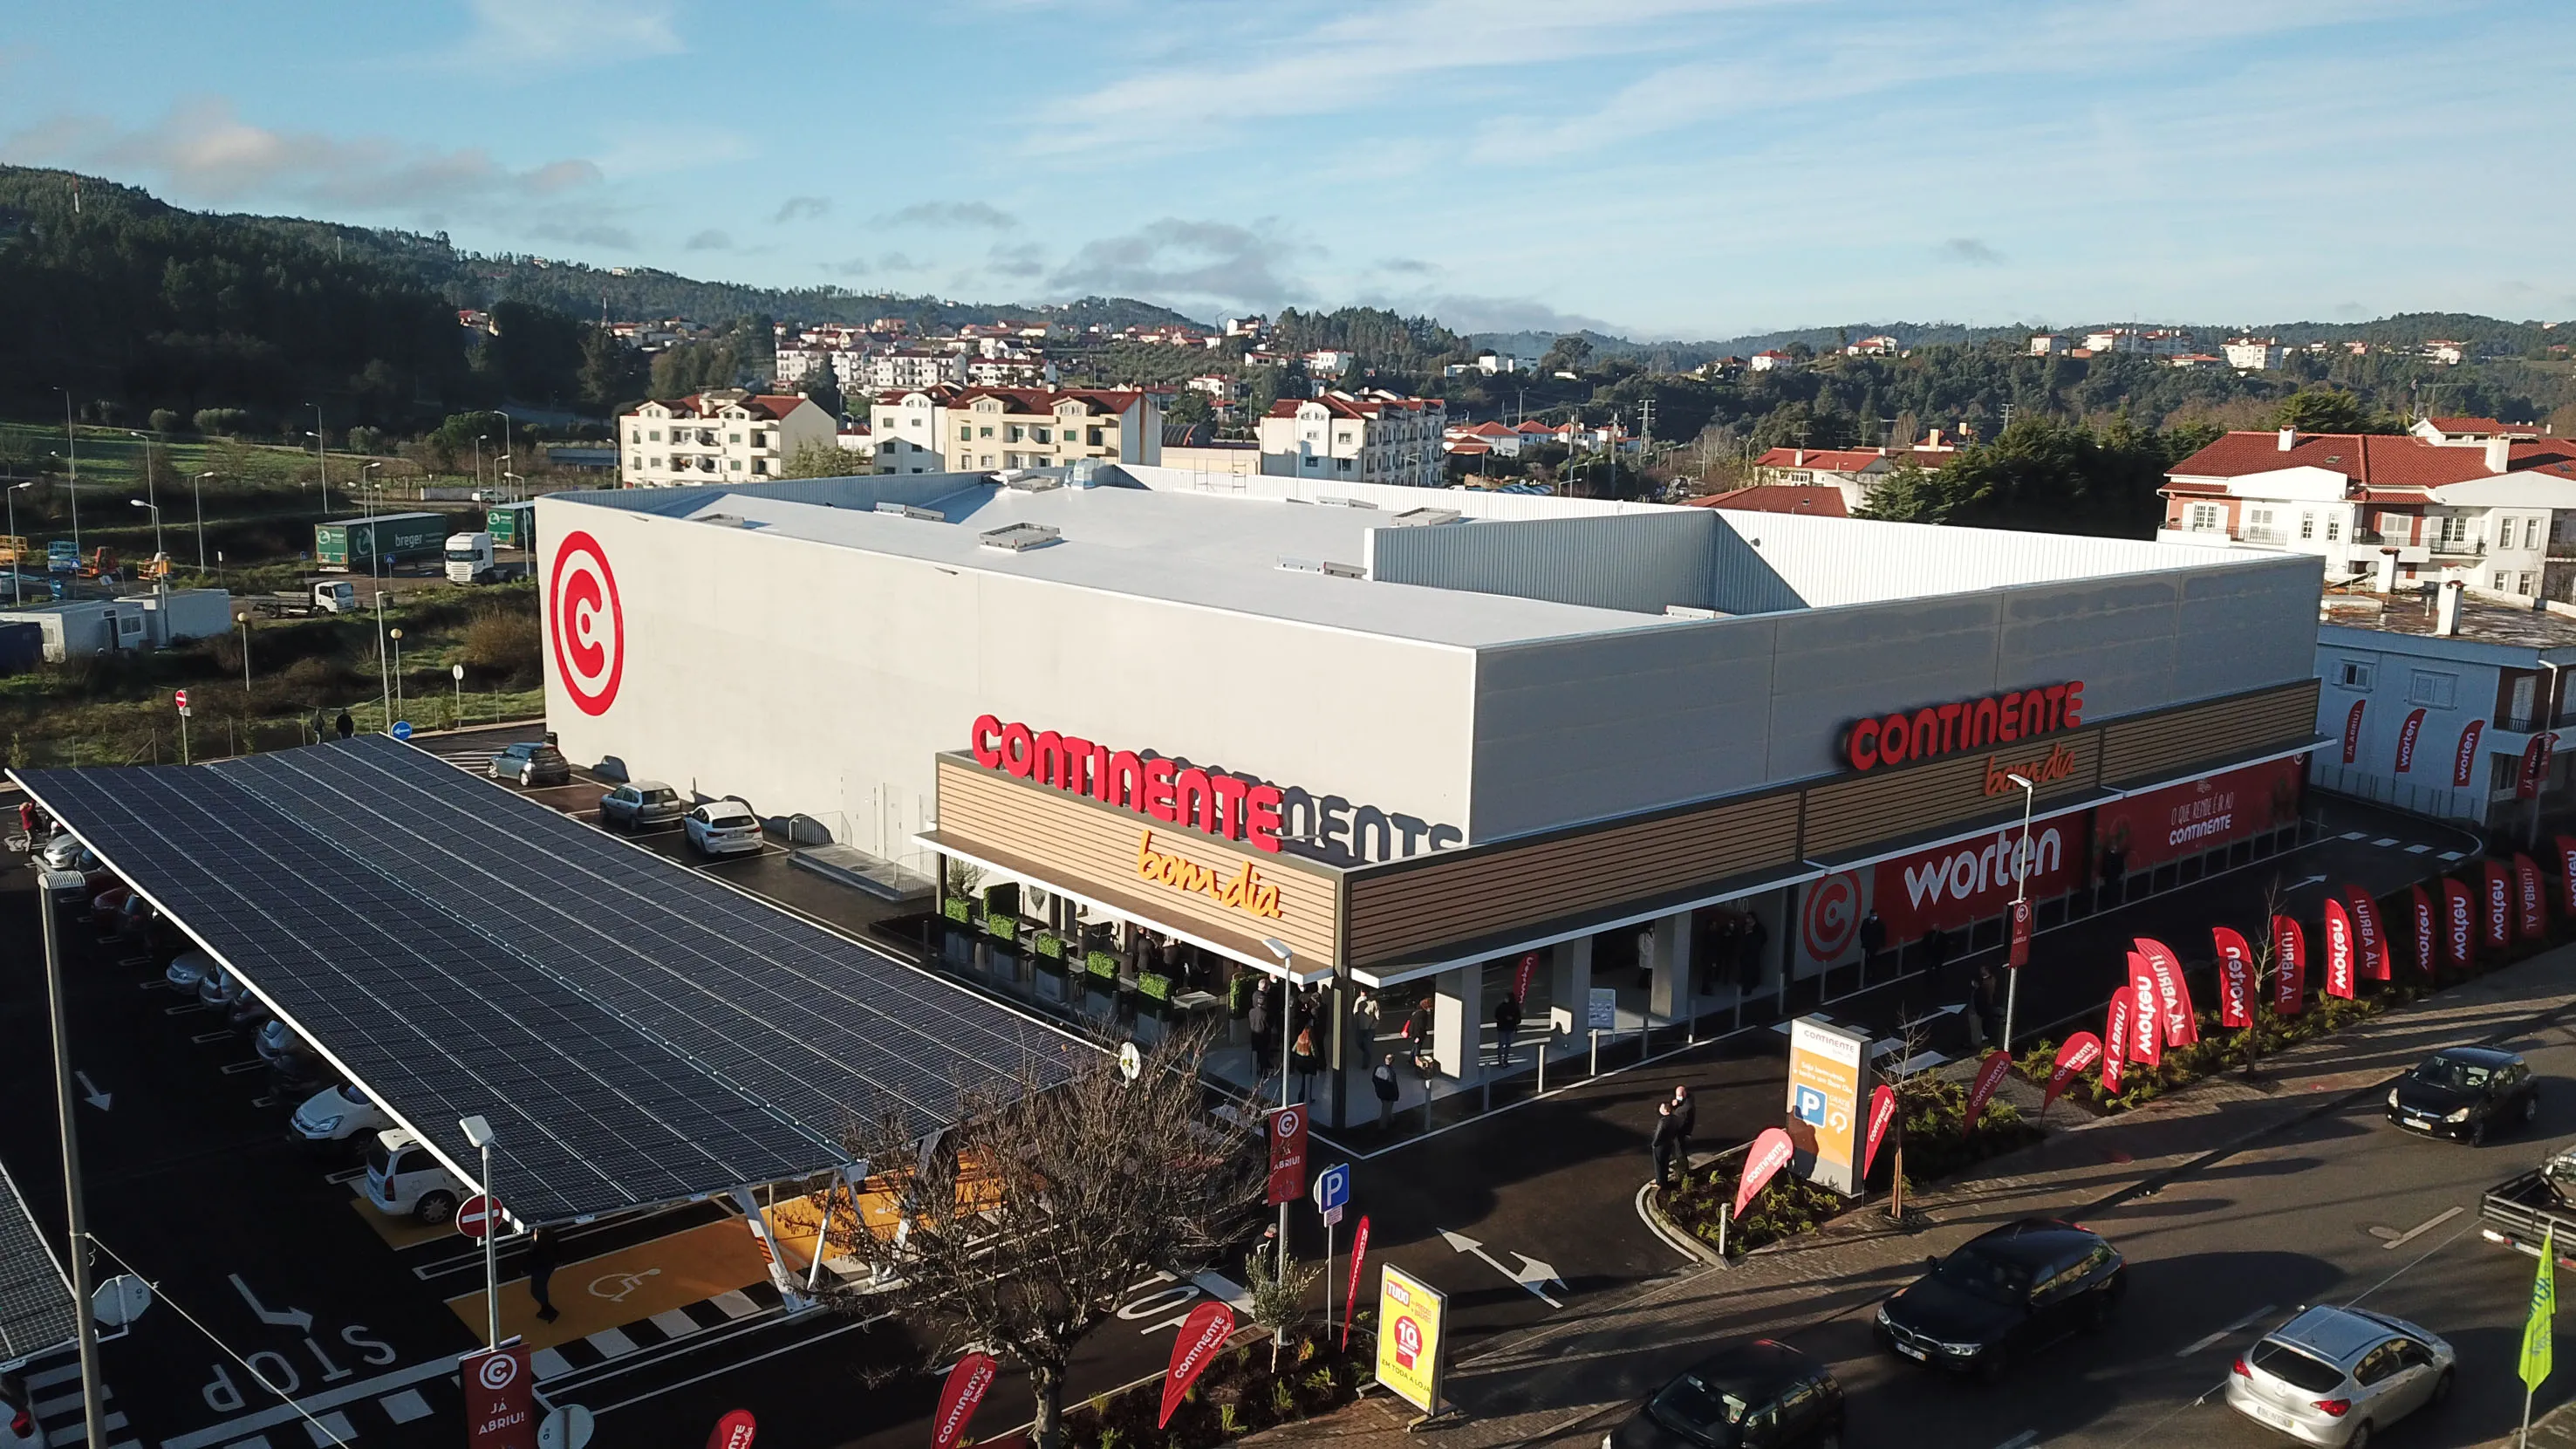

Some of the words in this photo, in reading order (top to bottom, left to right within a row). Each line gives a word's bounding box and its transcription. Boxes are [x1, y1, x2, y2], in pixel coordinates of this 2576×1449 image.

[395, 533, 423, 548] breger
[1846, 680, 2086, 770] CONTINENTE
[2400, 720, 2418, 768] worten
[2041, 742, 2076, 783] dia
[2458, 732, 2476, 781] worten
[971, 714, 1283, 853] CONTINENTE
[2169, 813, 2232, 846] CONTINENTE
[1138, 830, 1222, 901] bom
[1221, 860, 1283, 919] dia
[1903, 827, 2062, 912] worten
[1803, 1029, 1855, 1054] CONTINENTE
[2053, 1041, 2094, 1082] CONTINENTE
[1972, 1059, 2006, 1108] CONTINENTE
[1869, 1096, 1891, 1143] CONTINENTE
[1746, 1140, 1787, 1183] CONTINENTE
[1327, 1172, 1343, 1207] P
[1387, 1281, 1410, 1306] TUDO
[202, 1324, 396, 1412] STOP
[1174, 1315, 1225, 1378] CONTINENTE
[1381, 1357, 1390, 1369] EM
[1391, 1363, 1409, 1380] TODA
[478, 1411, 524, 1436] ABRIU!
[490, 1397, 508, 1414] JÁ
